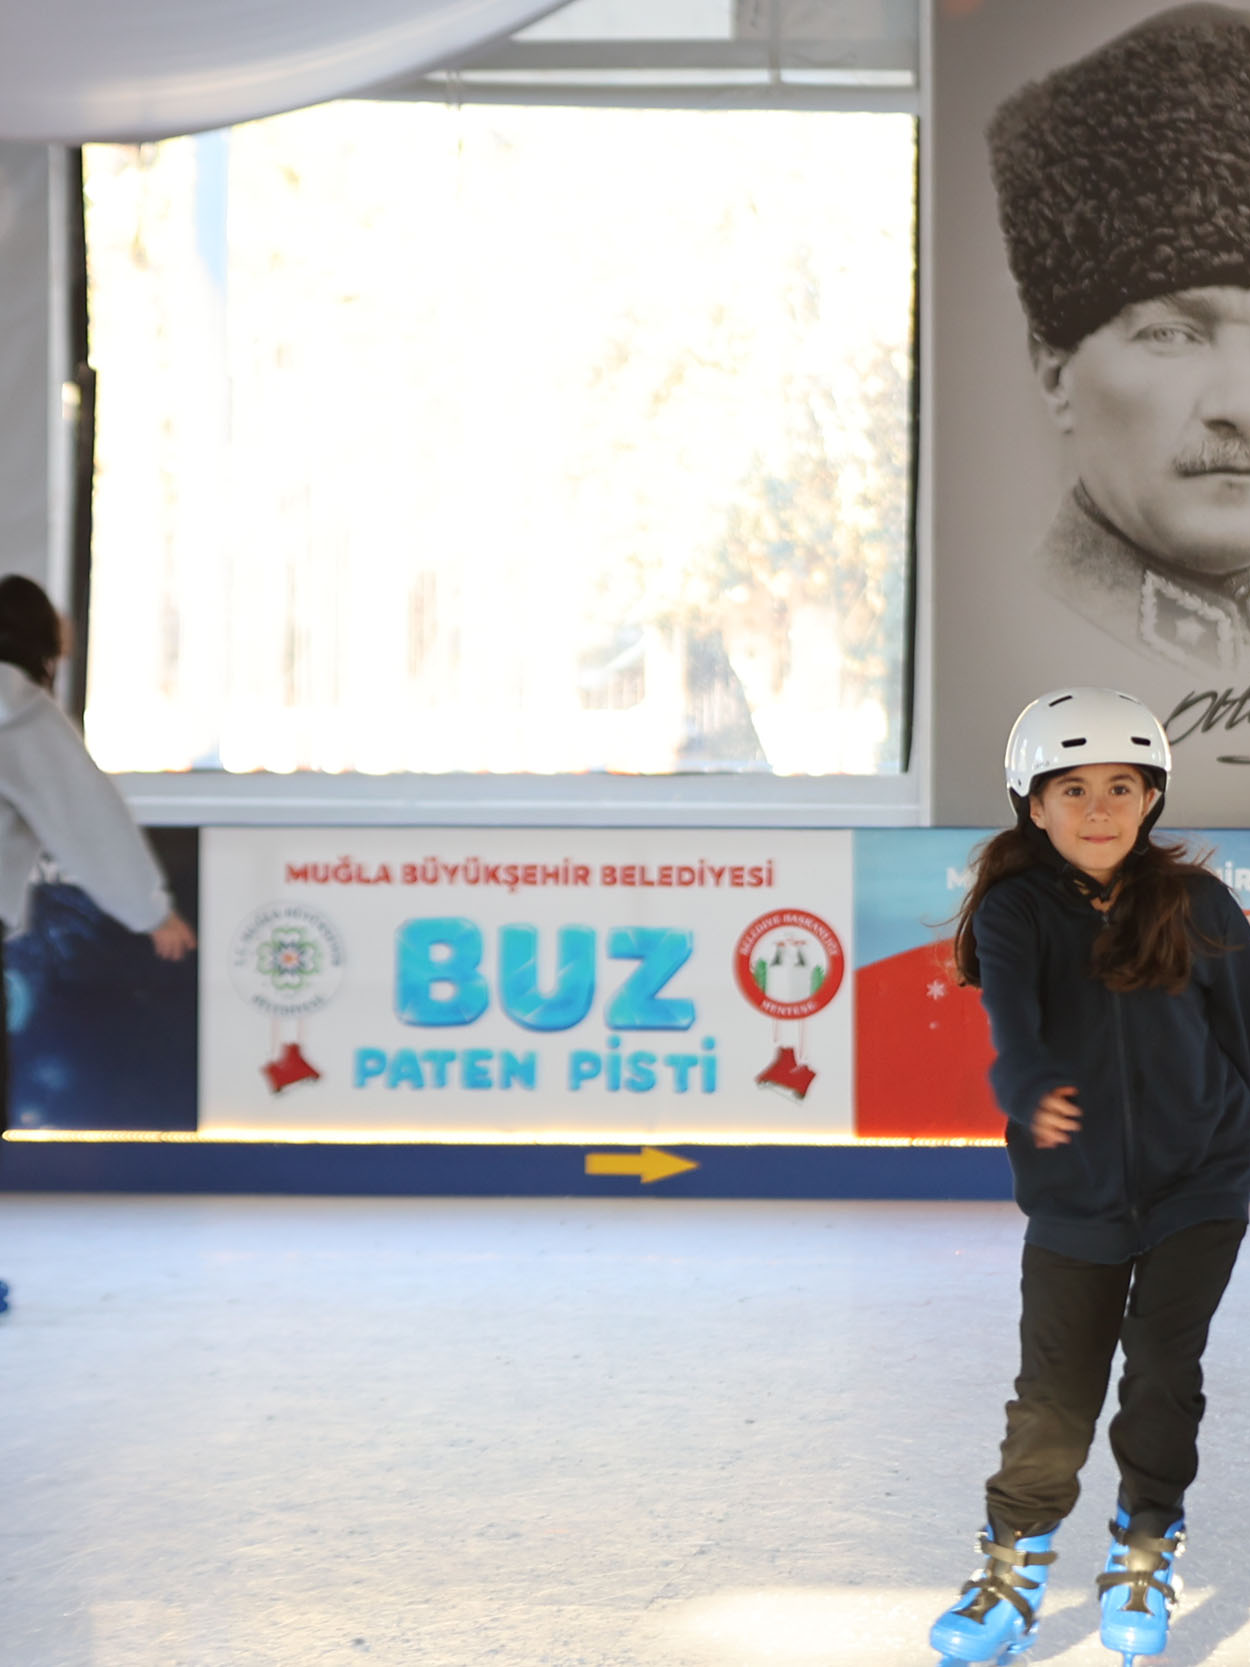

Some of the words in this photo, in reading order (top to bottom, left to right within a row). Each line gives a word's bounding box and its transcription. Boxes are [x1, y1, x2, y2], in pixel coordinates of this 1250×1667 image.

[284, 856, 392, 886] MUĞLA
[401, 857, 590, 893] BÜYÜKŞEHİR
[601, 858, 774, 888] BELEDİYESİ
[394, 916, 696, 1033] BUZ
[353, 1046, 537, 1091] PATEN
[568, 1034, 718, 1094] PİSTİ
